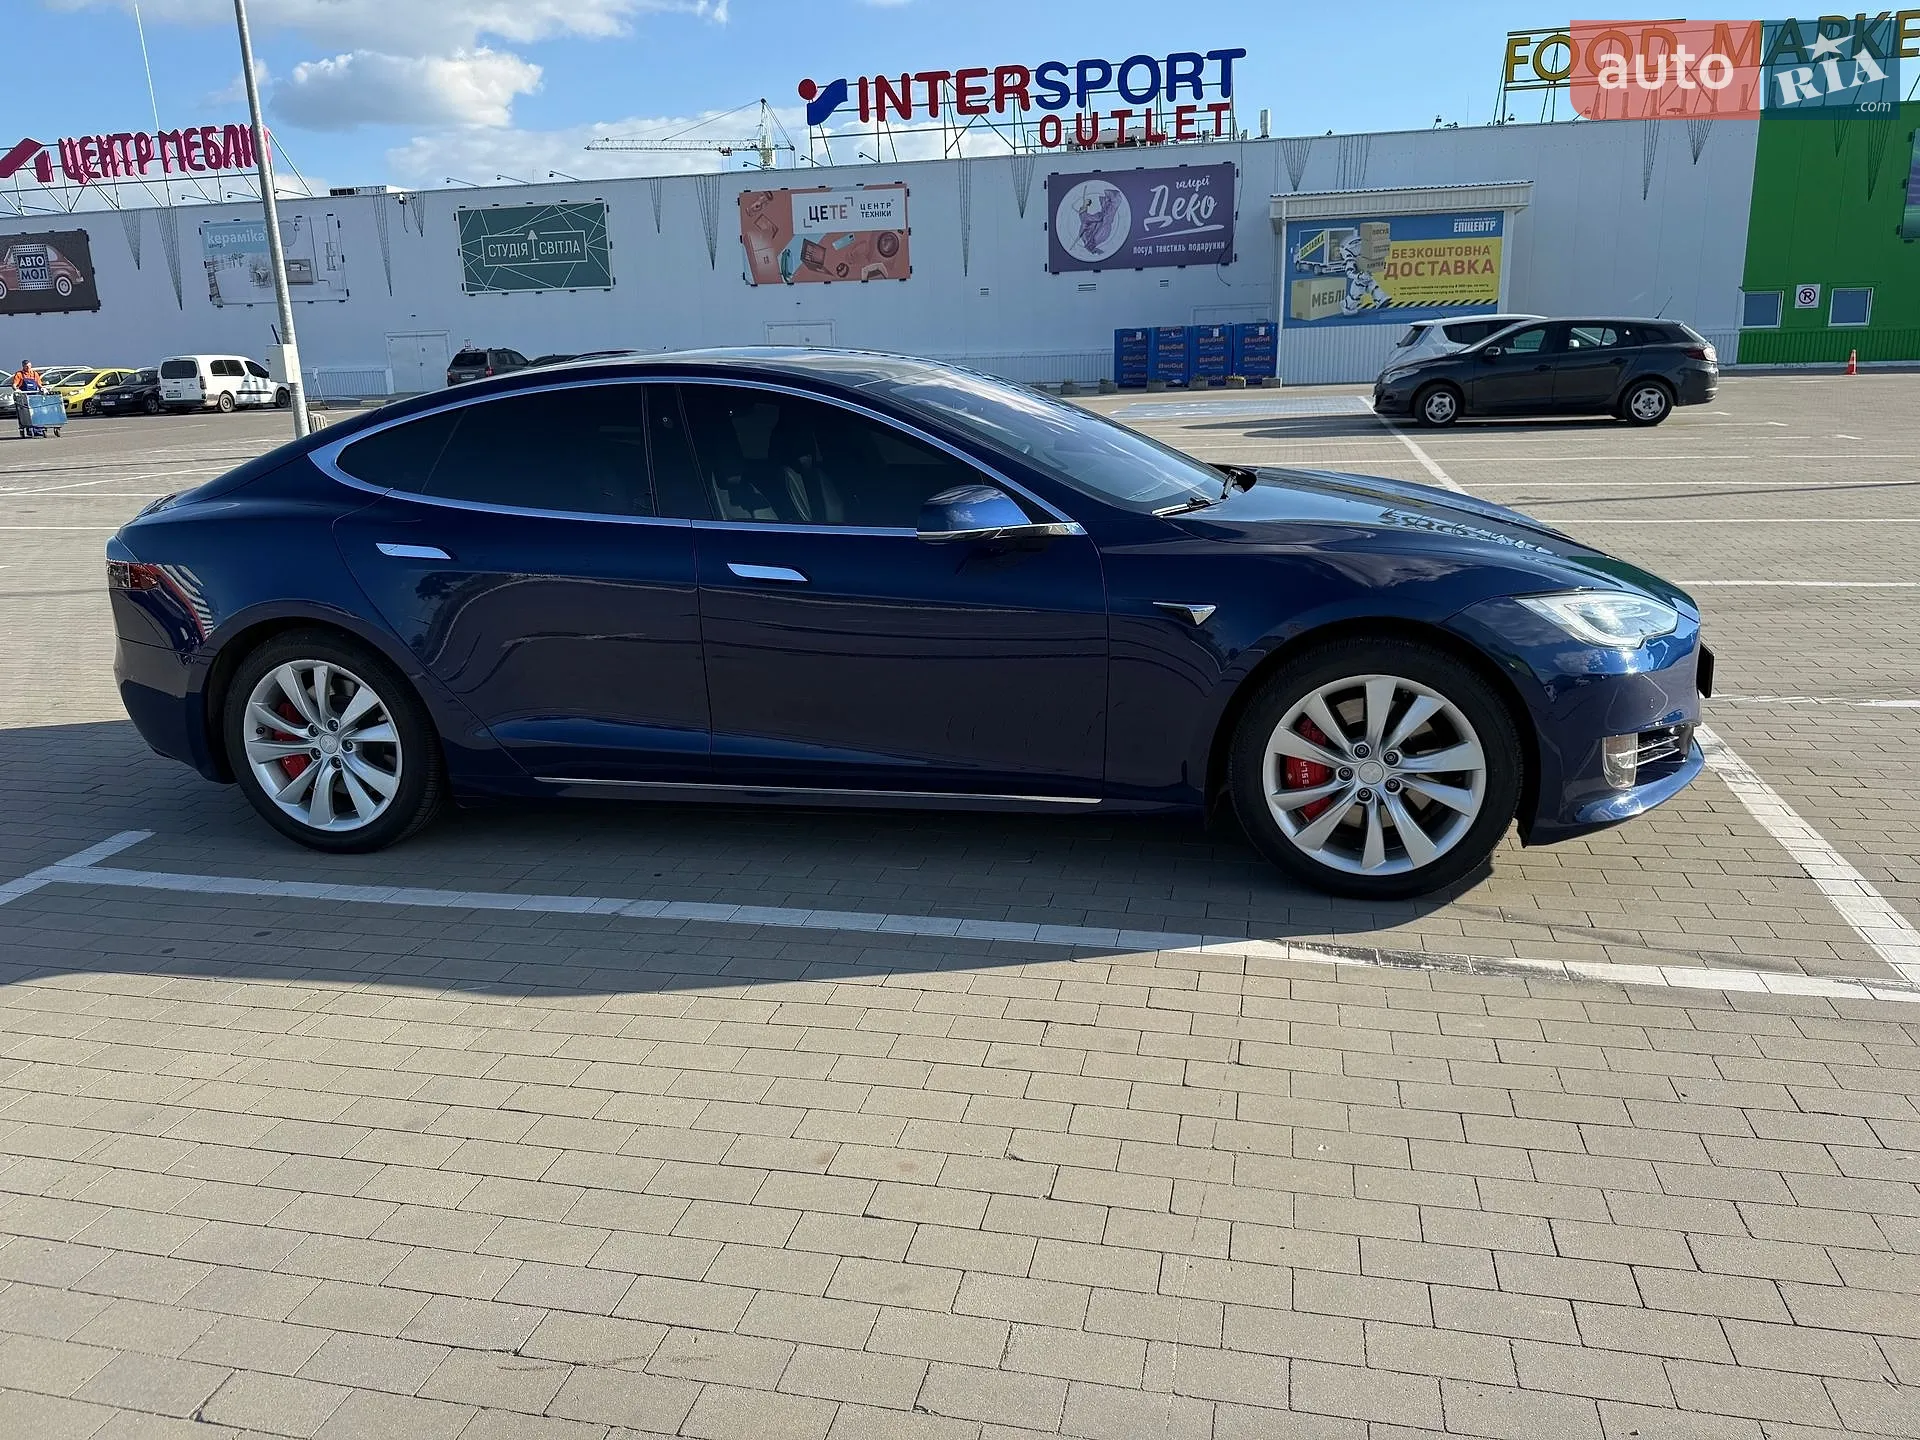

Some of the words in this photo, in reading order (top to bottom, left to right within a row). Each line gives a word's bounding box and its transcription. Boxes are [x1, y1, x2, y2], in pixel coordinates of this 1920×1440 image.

[1506, 28, 1677, 82] FOOD
[857, 48, 1247, 123] INTERSPORT
[1039, 102, 1231, 148] OUTLET
[58, 132, 155, 184] ЦЕНТР
[808, 204, 848, 222] ЦЕТЕ
[860, 202, 892, 211] ЦЕНТР
[861, 210, 892, 219] ТЕХНІКИ
[1143, 184, 1218, 231] Деко
[1453, 220, 1496, 233] ЕПІЦЕНТР
[488, 241, 530, 259] СТУДІЯ
[539, 239, 581, 257] СВІТЛА
[1392, 245, 1491, 259] БЕЗКОШТОВНА
[19, 256, 44, 267] АВТО
[1383, 259, 1495, 281] ДОСТАВКА
[21, 269, 48, 281] МОЛ
